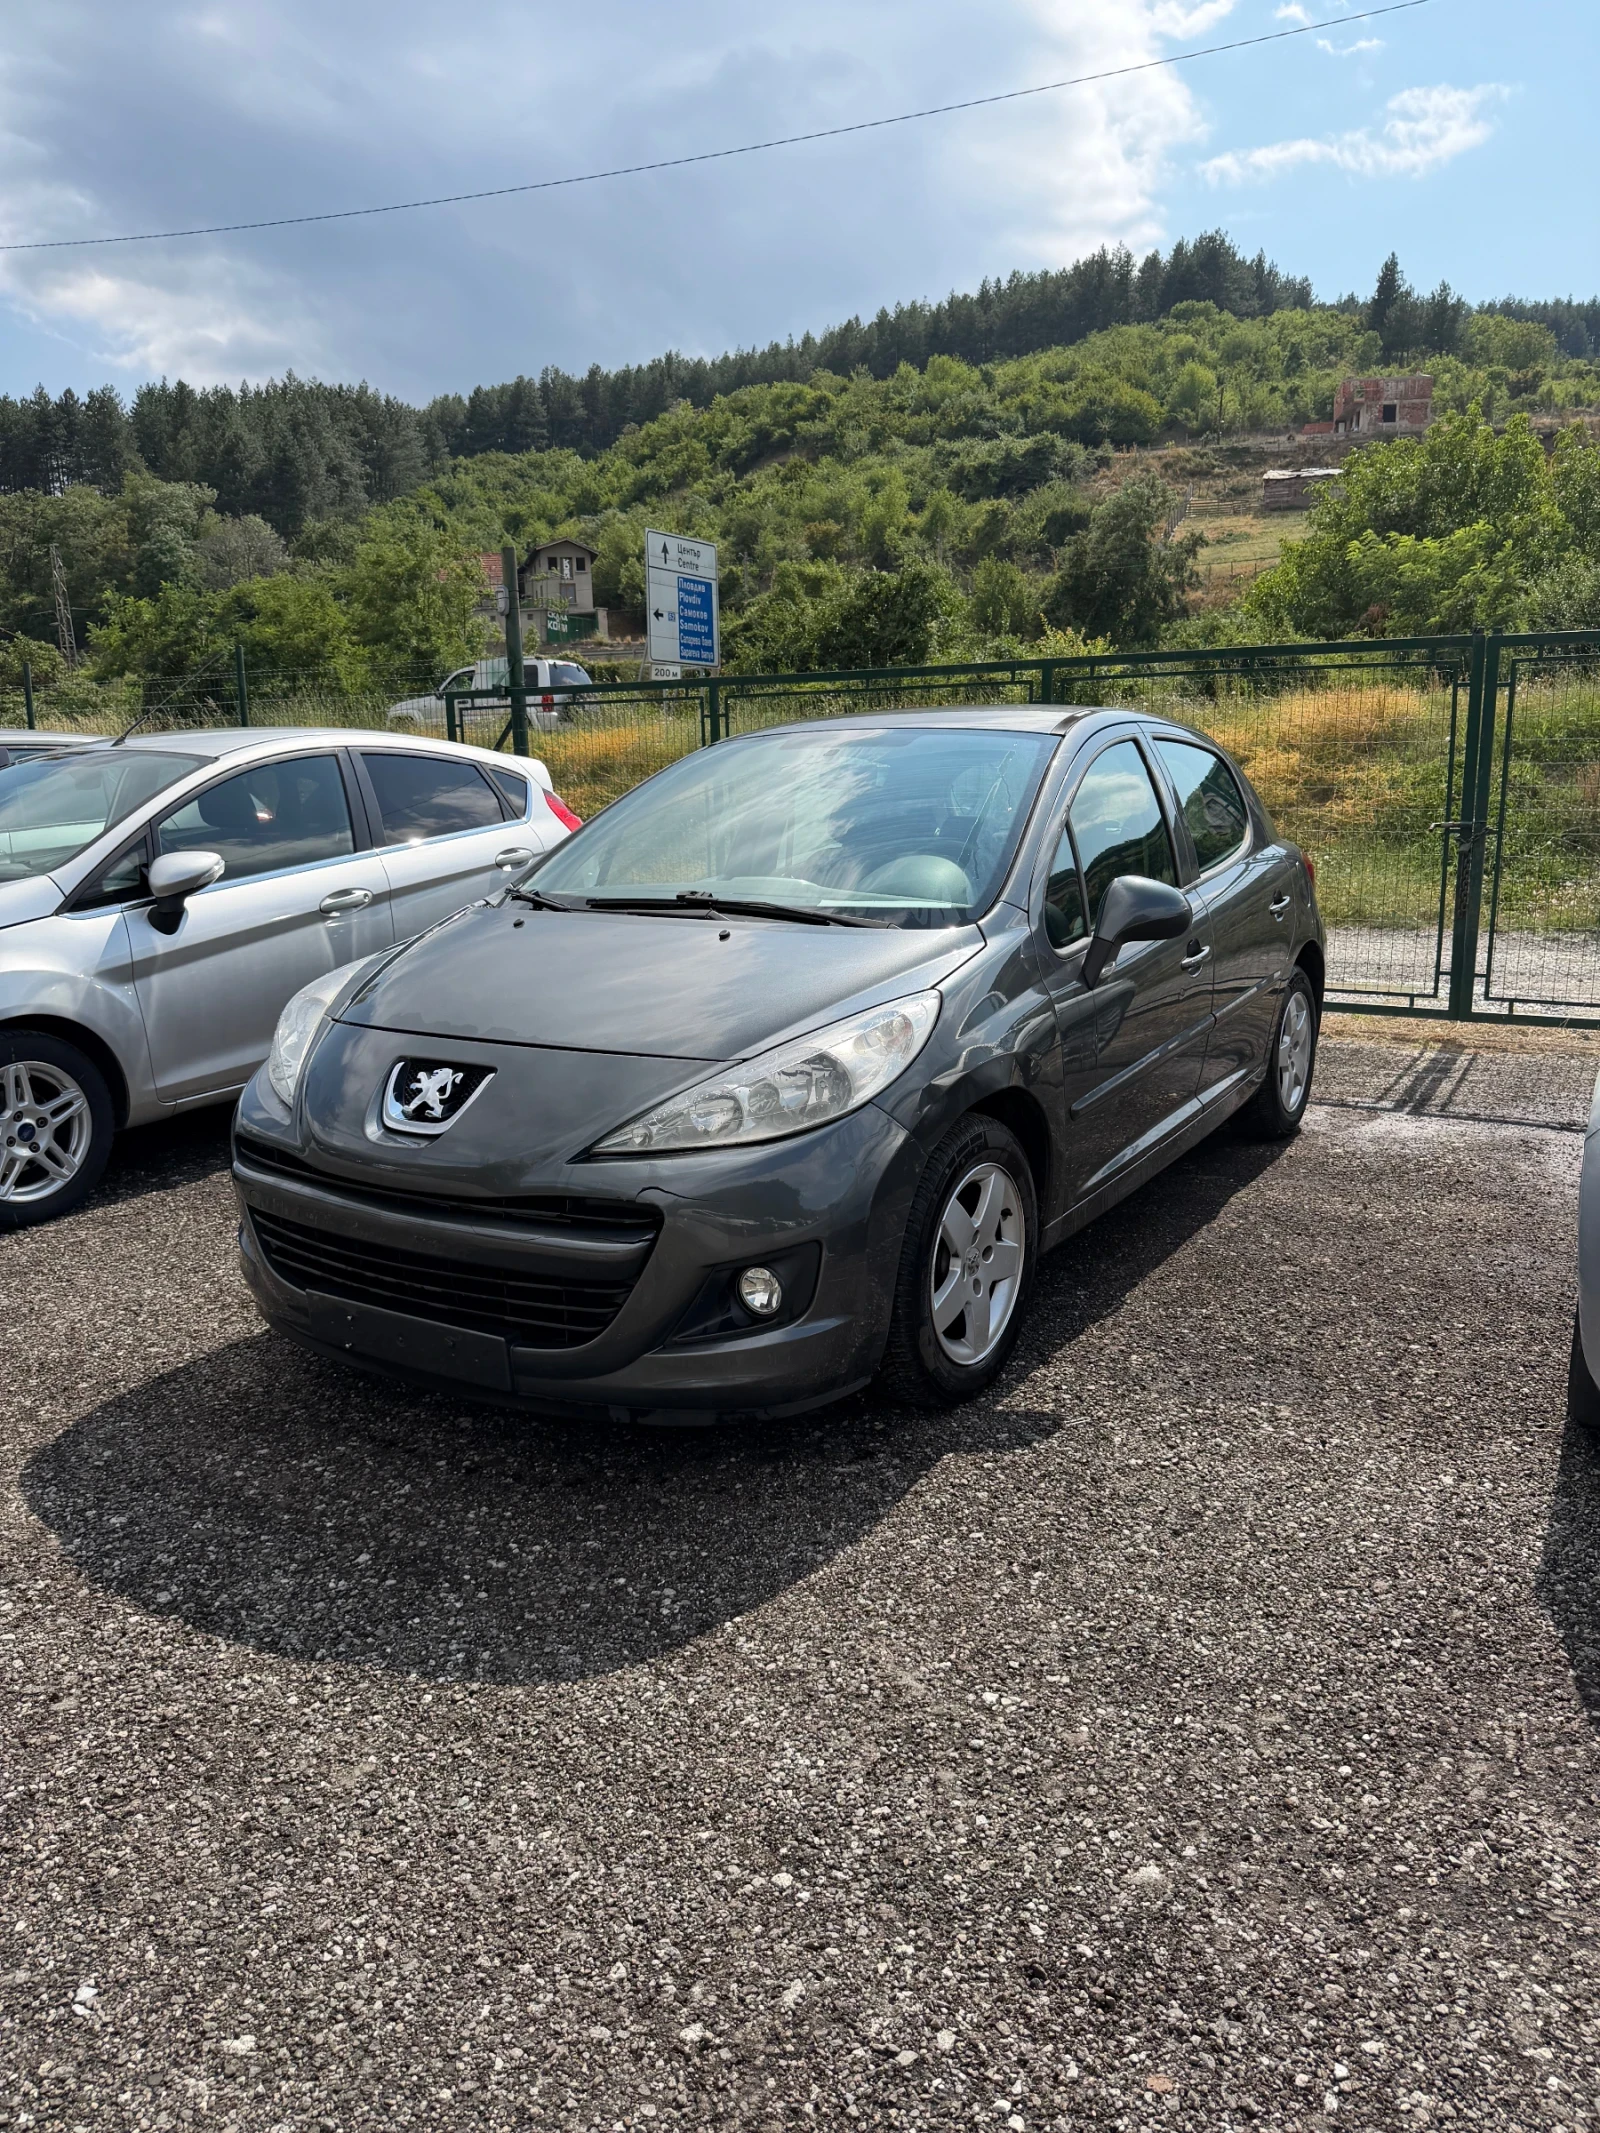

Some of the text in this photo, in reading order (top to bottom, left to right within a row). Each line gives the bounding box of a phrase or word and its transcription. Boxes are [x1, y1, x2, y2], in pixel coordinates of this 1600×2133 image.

[677, 543, 701, 560] Център
[677, 557, 700, 572] Centre
[678, 578, 706, 593] Пловдив
[679, 591, 702, 605] Plovdiv
[680, 605, 708, 620] Самоков
[680, 619, 709, 633] Samokov
[654, 668, 671, 677] 200
